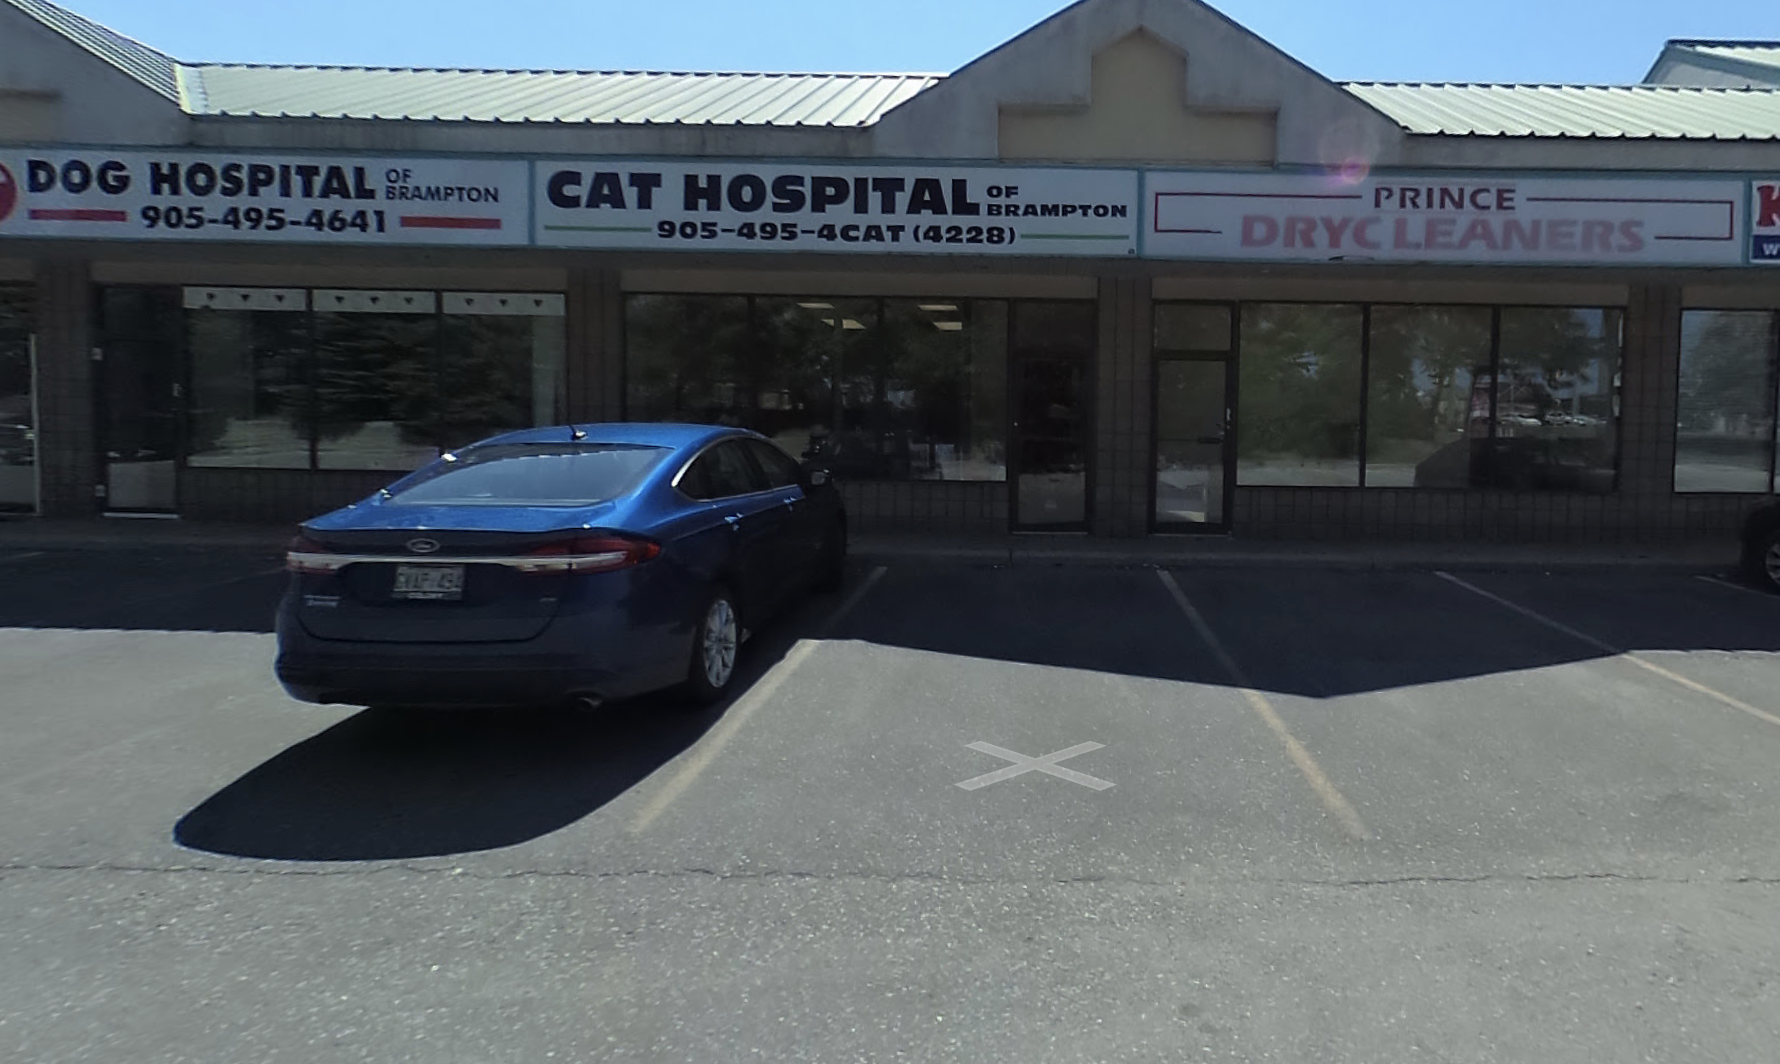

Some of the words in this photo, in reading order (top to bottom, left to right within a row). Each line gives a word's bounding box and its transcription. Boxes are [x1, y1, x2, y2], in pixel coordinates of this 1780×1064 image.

[27, 159, 131, 194] DOG
[150, 161, 376, 200] HOSPITAL
[386, 169, 412, 184] OF
[386, 185, 499, 203] BRAMPTON
[546, 170, 662, 210] CAT
[683, 173, 981, 216] HOSPITAL
[986, 185, 1019, 199] OF
[1373, 186, 1517, 211] PRINCE
[141, 206, 386, 233] 905-495-4641
[986, 203, 1127, 218] BRAMPTON
[657, 221, 905, 243] 905-495-4CAT
[912, 226, 1016, 245] (4228)
